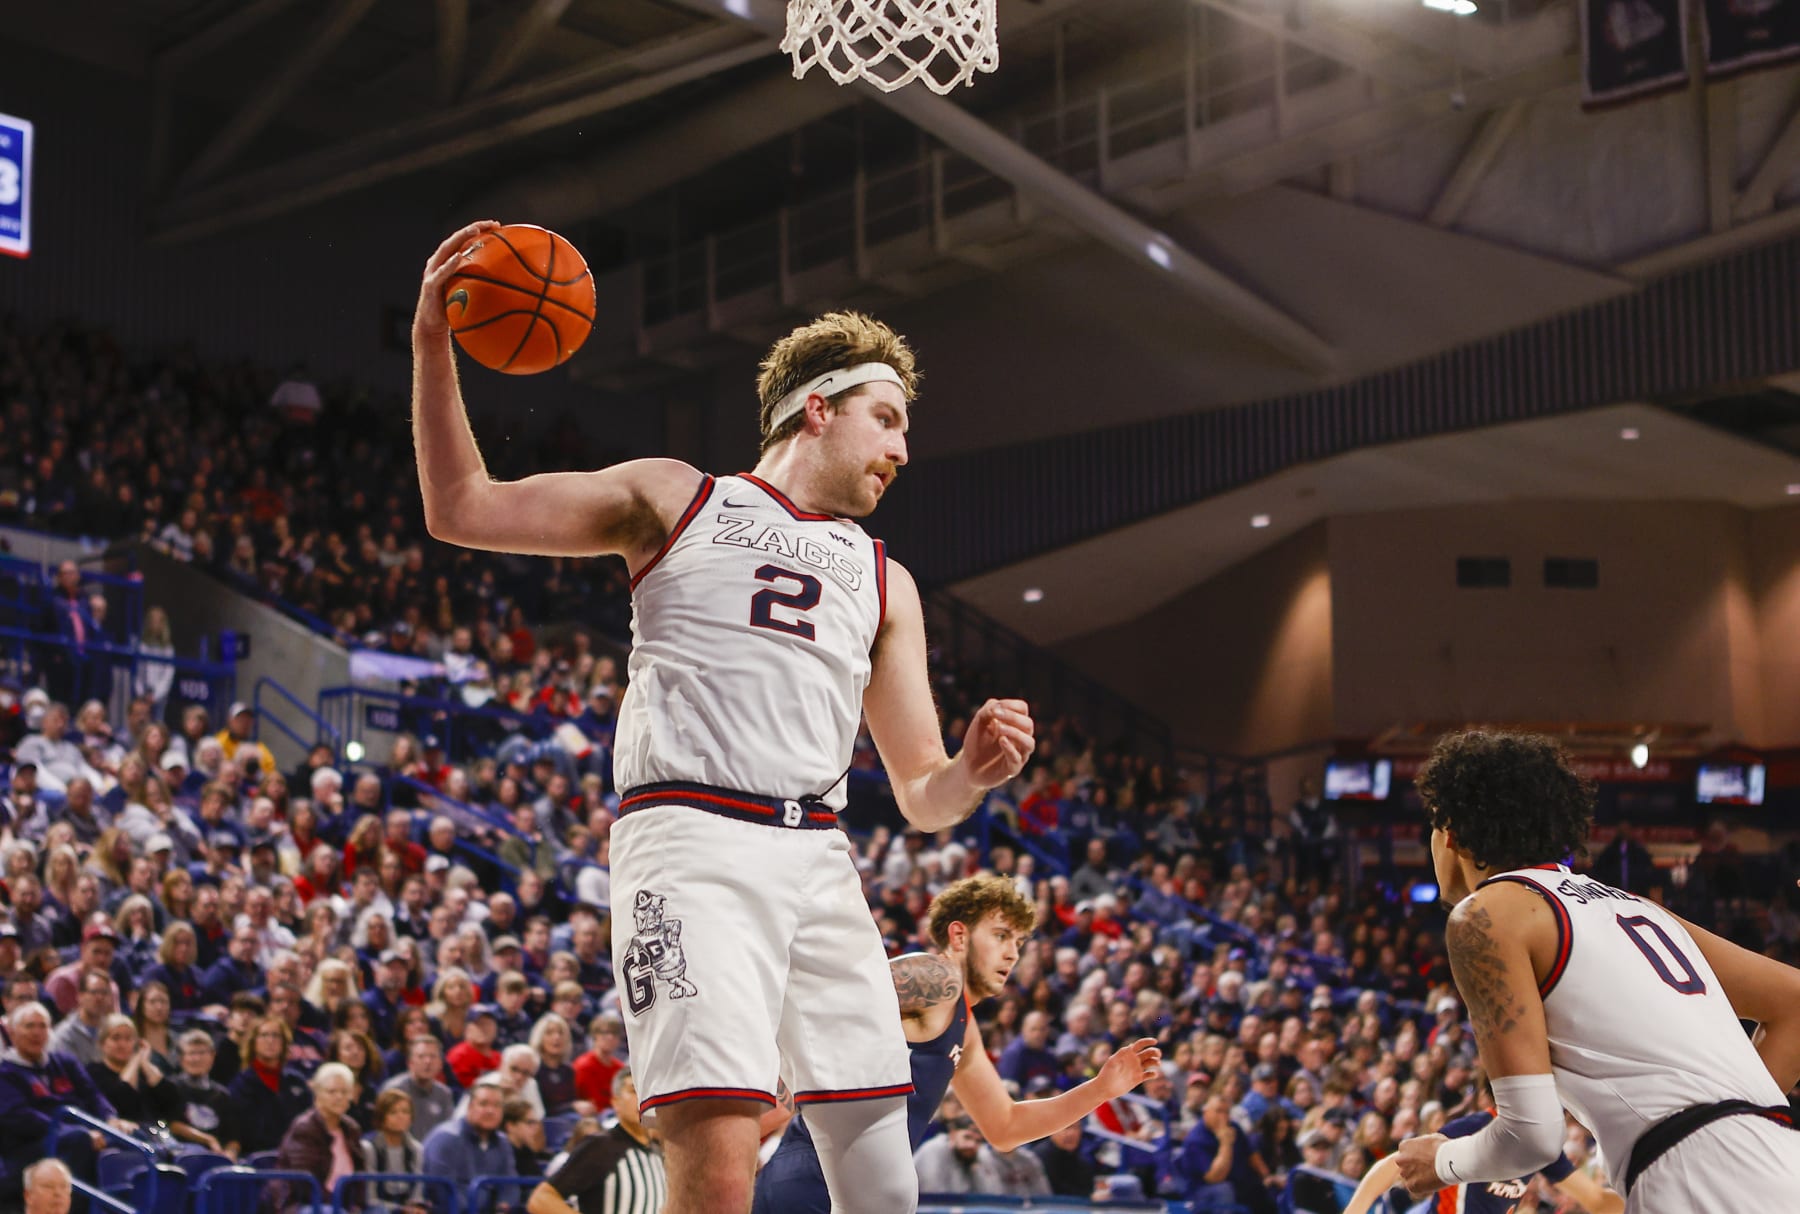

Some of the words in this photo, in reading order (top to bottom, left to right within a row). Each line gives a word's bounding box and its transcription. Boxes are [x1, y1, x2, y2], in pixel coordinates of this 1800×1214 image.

[713, 514, 862, 591] ZAGS
[750, 564, 822, 641] 2
[623, 951, 656, 1017] G
[1616, 913, 1706, 996] 0
